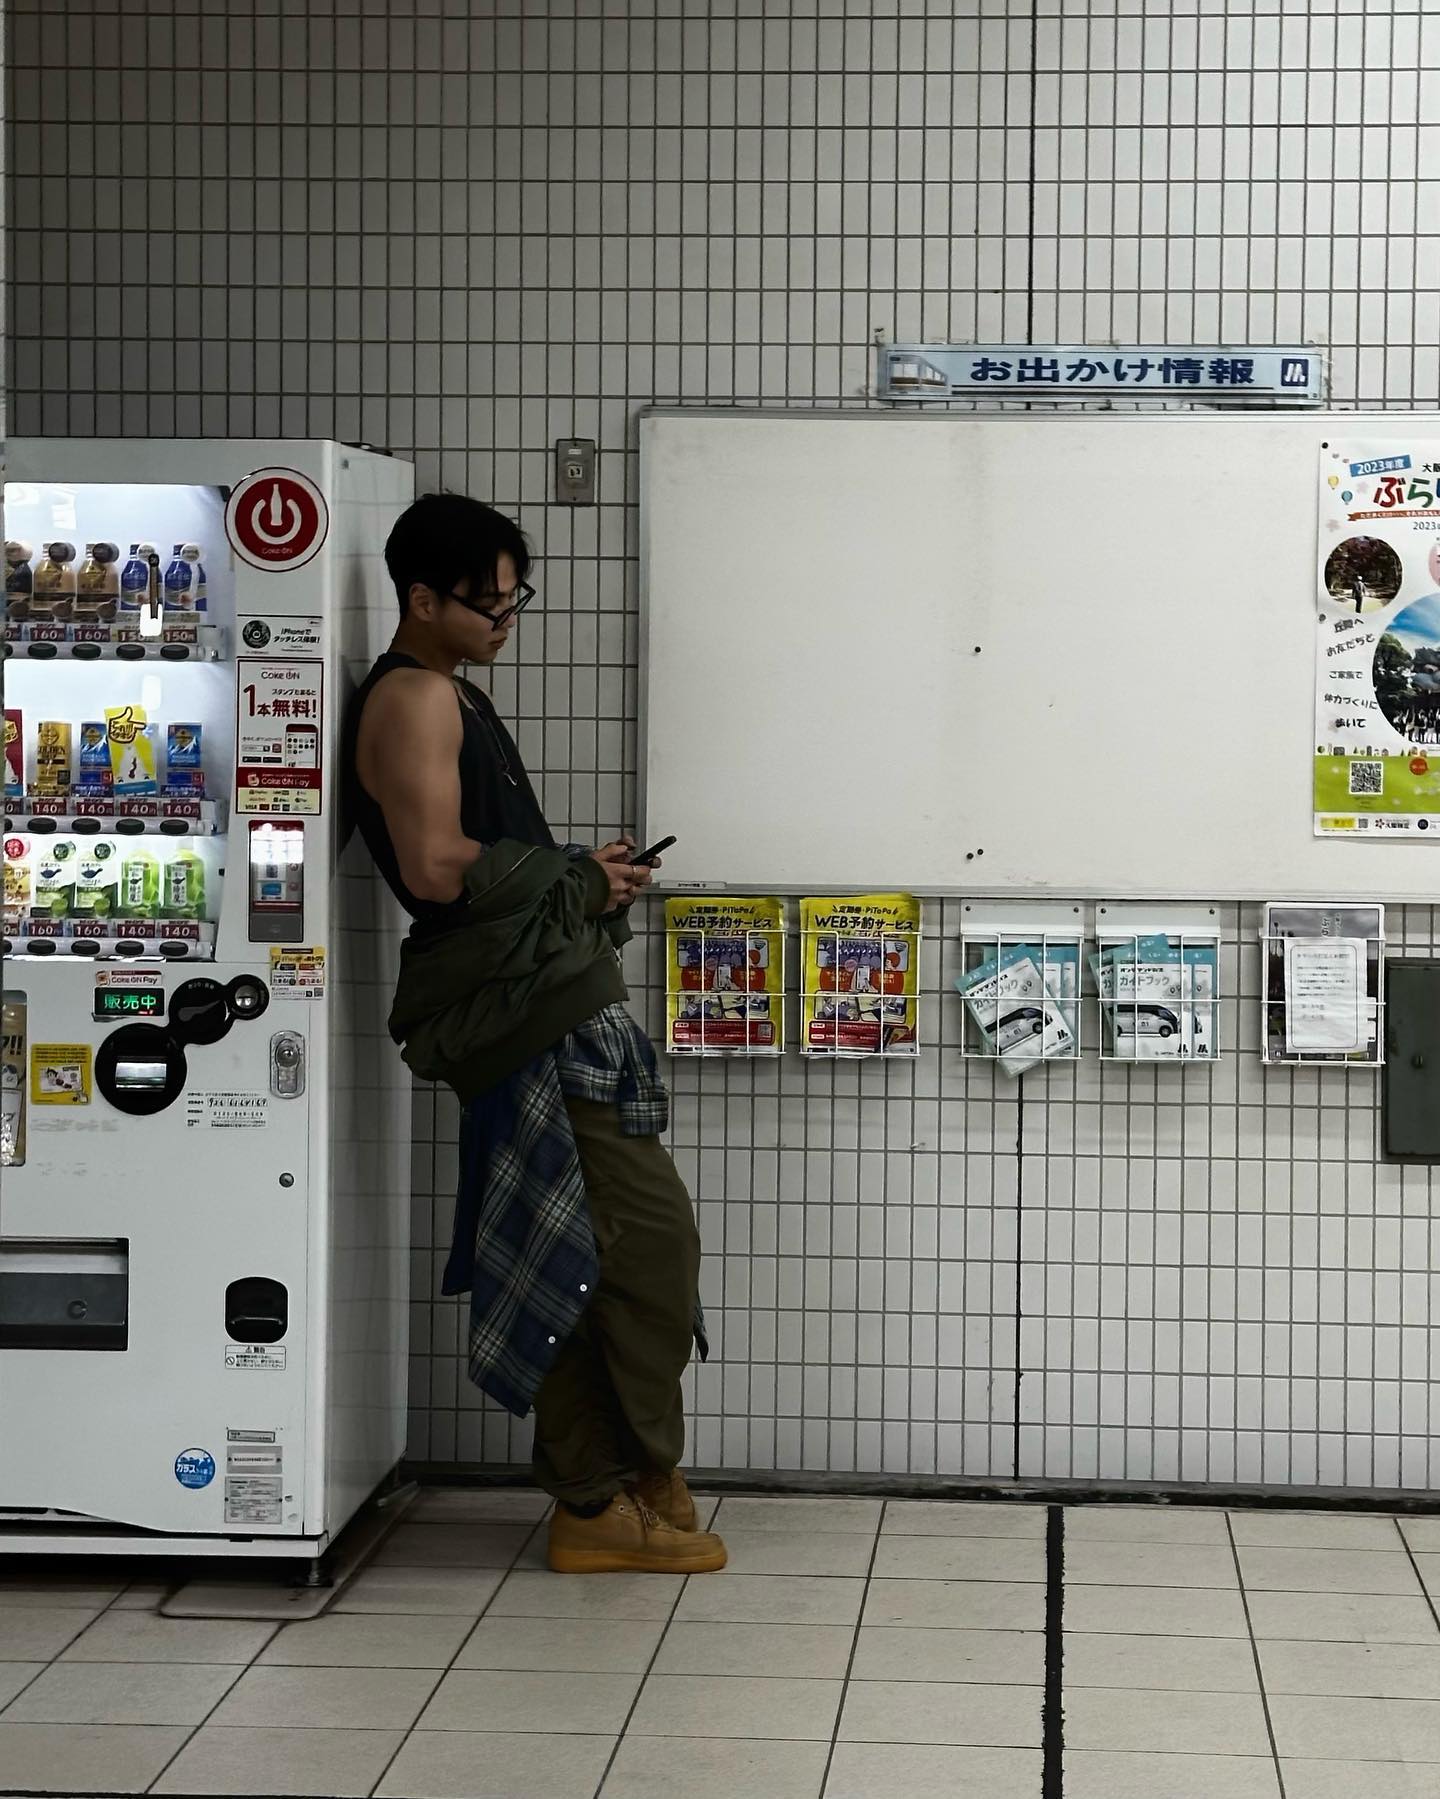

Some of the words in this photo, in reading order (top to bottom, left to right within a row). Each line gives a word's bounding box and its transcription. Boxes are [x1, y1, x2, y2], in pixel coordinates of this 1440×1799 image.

[970, 357, 1255, 384] お出かけ情報
[261, 671, 284, 680] Coke
[673, 915, 773, 929] WEB予約サービス
[815, 914, 914, 931] WEB予約サービス
[104, 994, 157, 1010] 販売中
